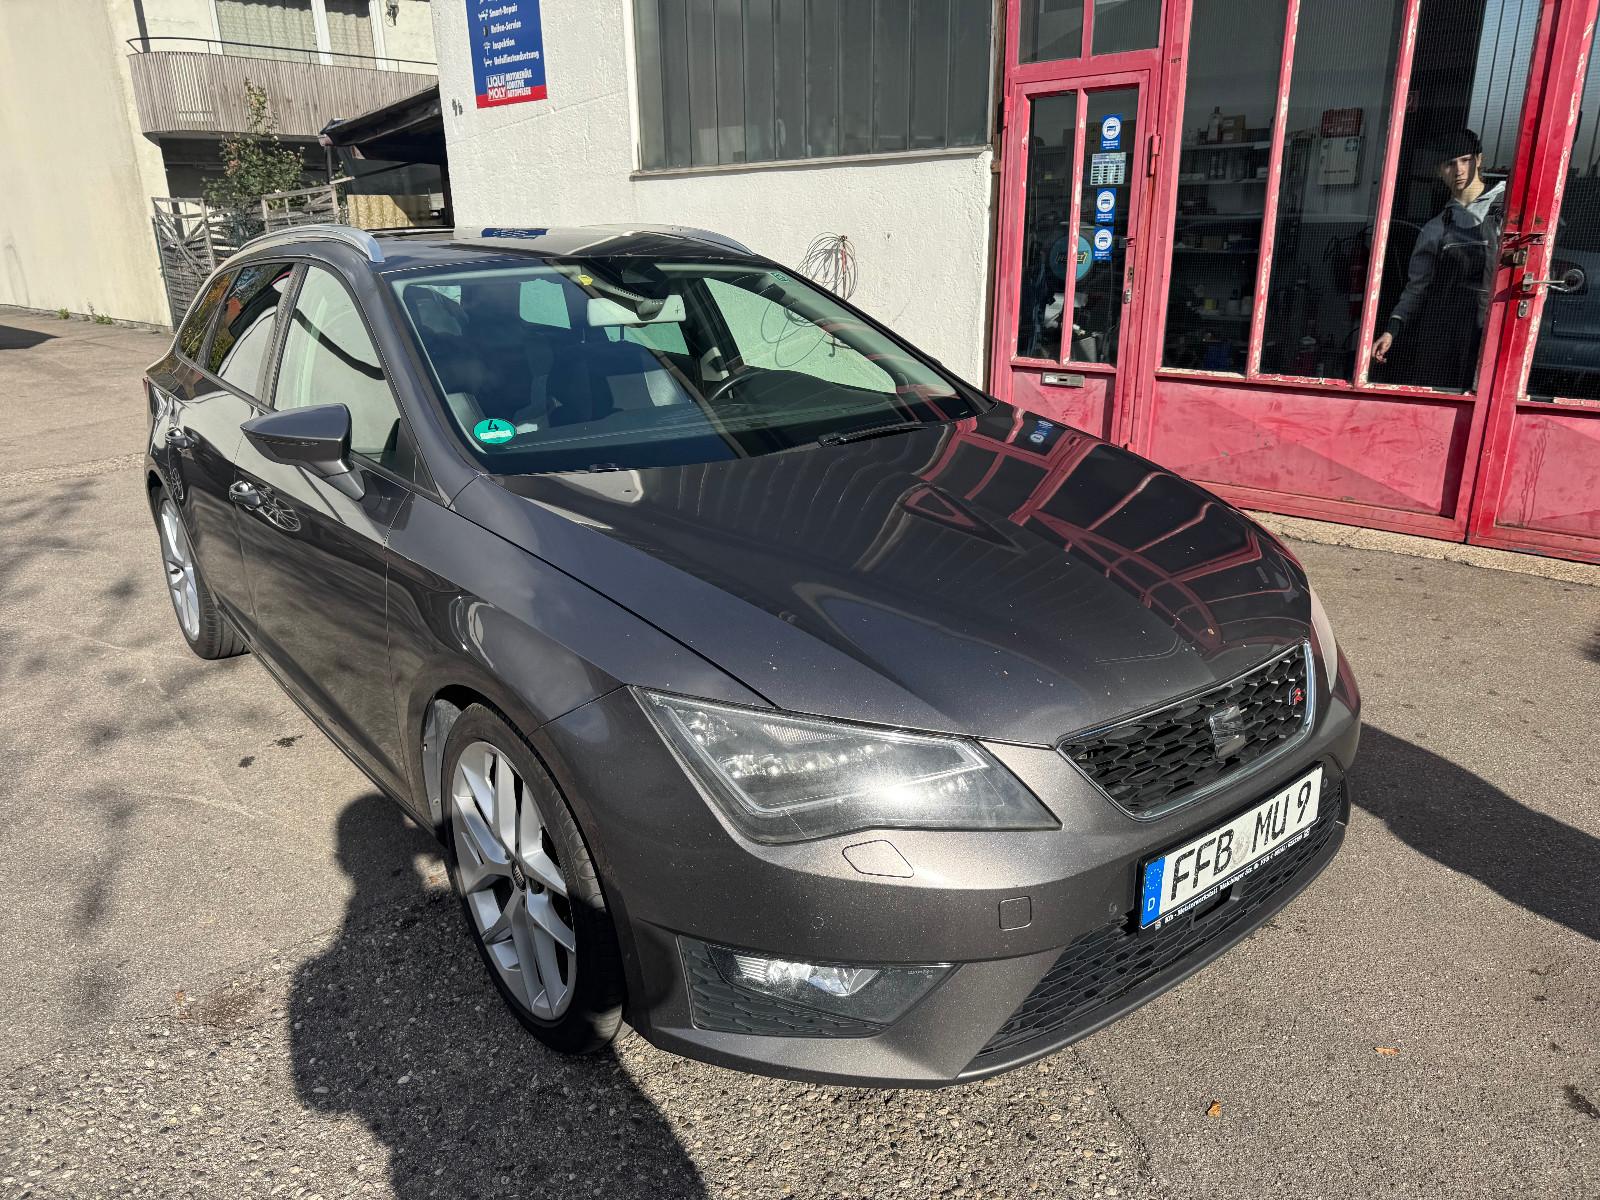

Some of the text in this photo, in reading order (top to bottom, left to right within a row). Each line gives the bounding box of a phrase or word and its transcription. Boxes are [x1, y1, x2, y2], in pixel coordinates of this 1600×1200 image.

[491, 19, 521, 33] Reifen-Service
[493, 38, 515, 50] Inspektion
[487, 74, 505, 87] LIQUI
[488, 87, 507, 99] MOLY
[488, 420, 499, 431] 4
[1171, 781, 1312, 901] FFB MU 9
[1147, 897, 1156, 912] D
